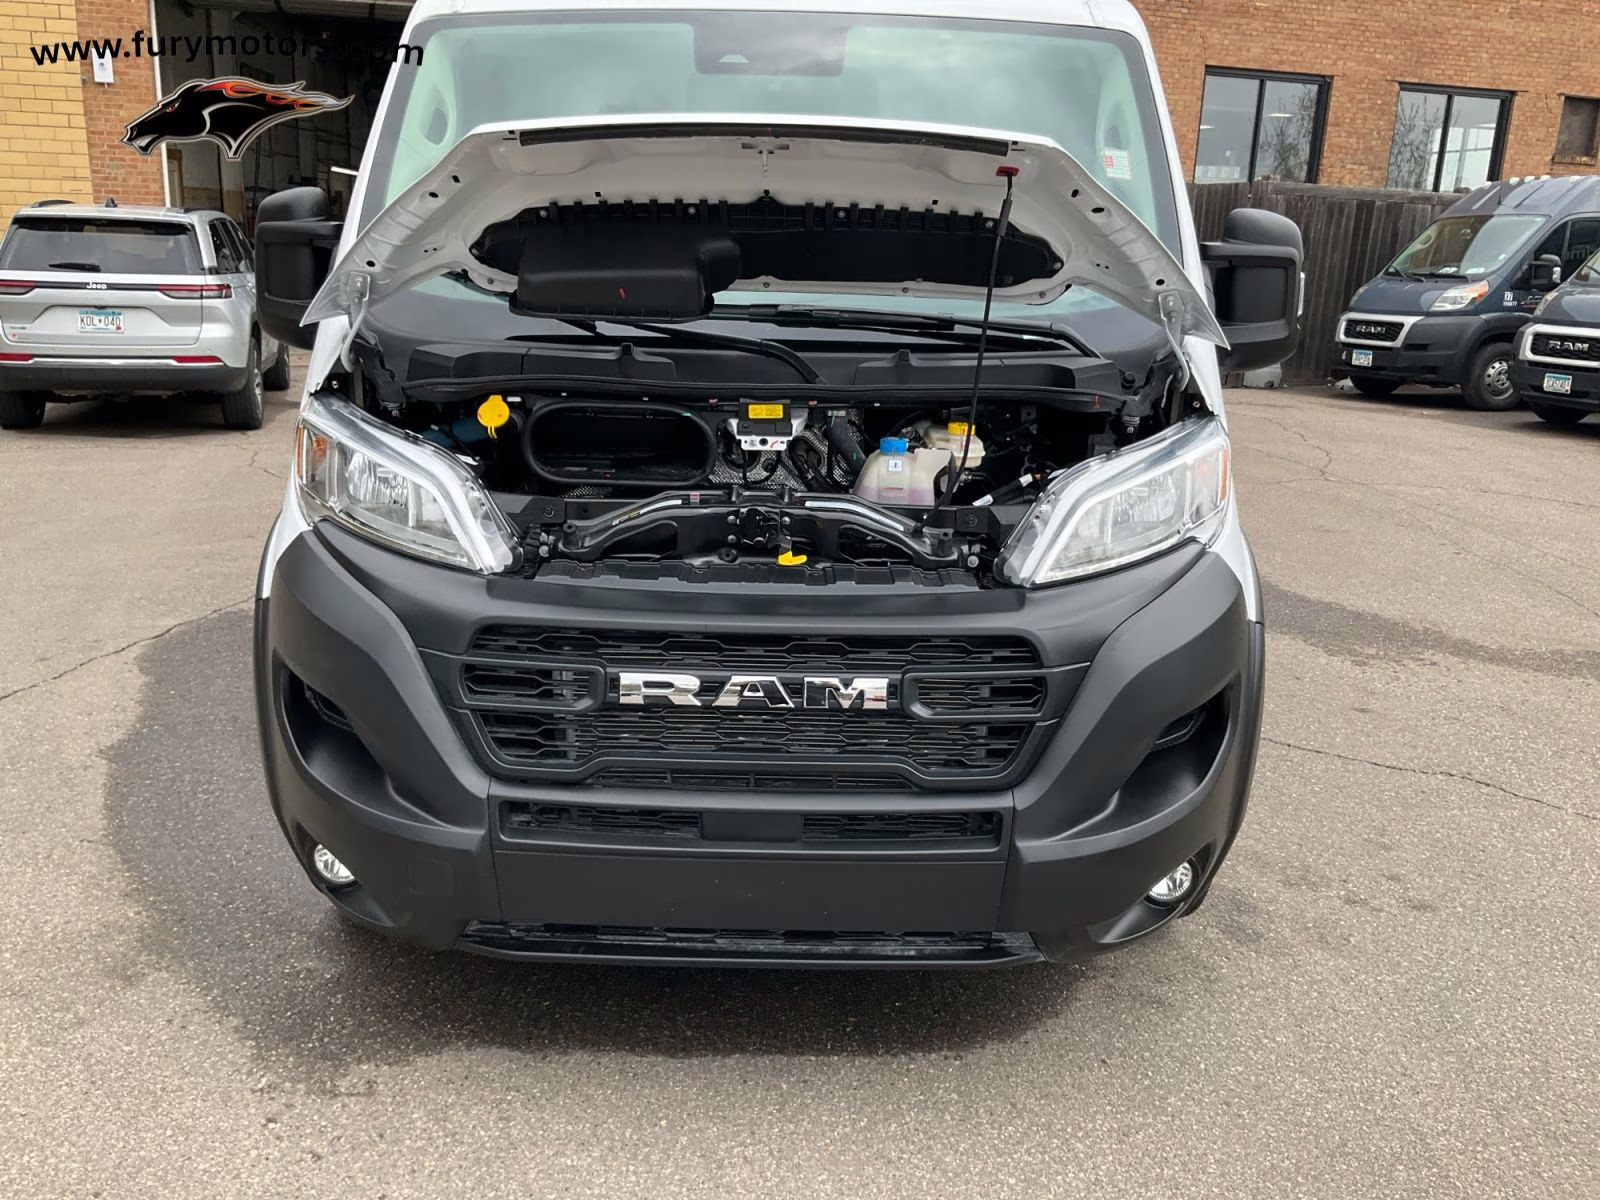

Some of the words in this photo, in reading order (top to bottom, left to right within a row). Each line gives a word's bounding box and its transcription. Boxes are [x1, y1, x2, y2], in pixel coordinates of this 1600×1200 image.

[86, 281, 107, 290] Jeep
[1356, 325, 1386, 334] RAM
[1548, 340, 1589, 352] RAM
[618, 671, 889, 710] RAM
